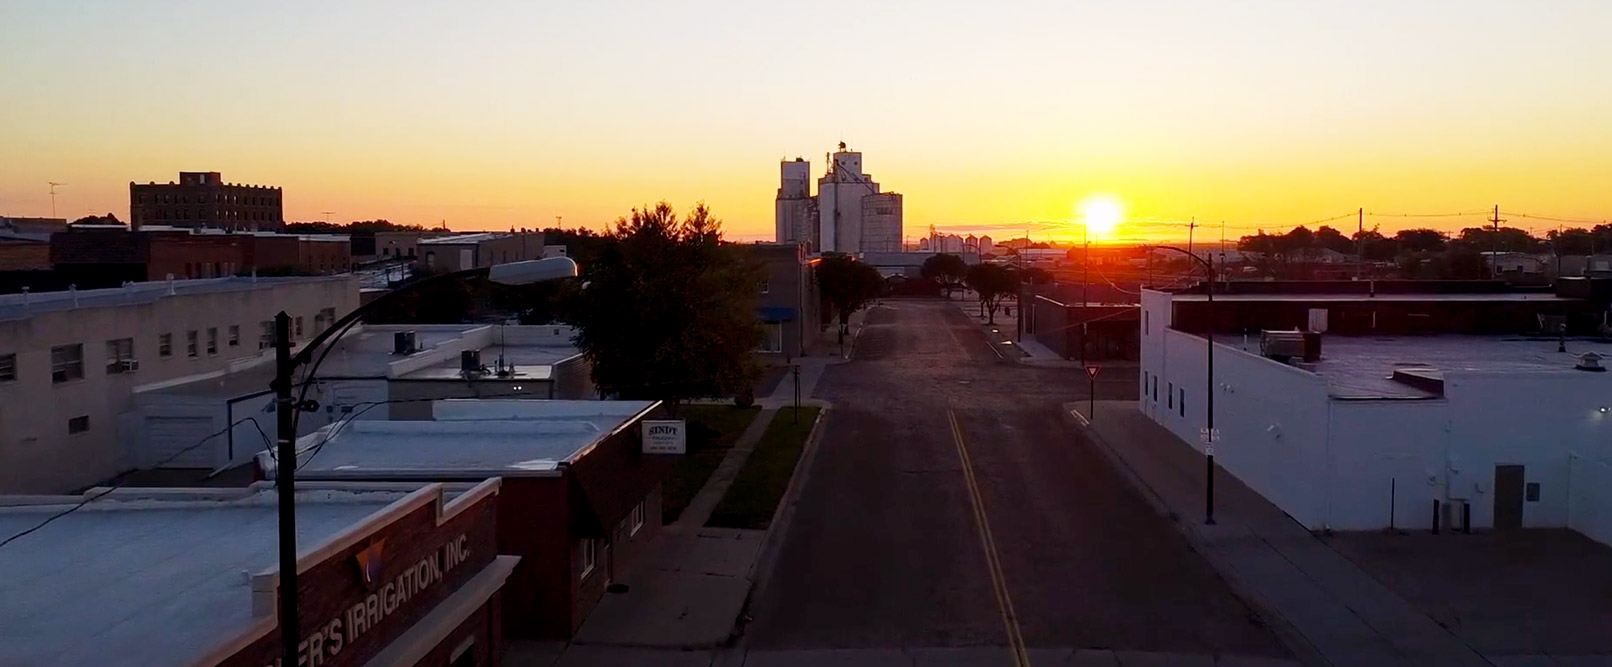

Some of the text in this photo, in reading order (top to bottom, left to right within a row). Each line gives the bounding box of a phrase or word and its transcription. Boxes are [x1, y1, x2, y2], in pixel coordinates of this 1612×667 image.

[649, 426, 678, 435] SINDT
[345, 551, 443, 644] IRRIGATION,
[446, 533, 470, 572] INC.
